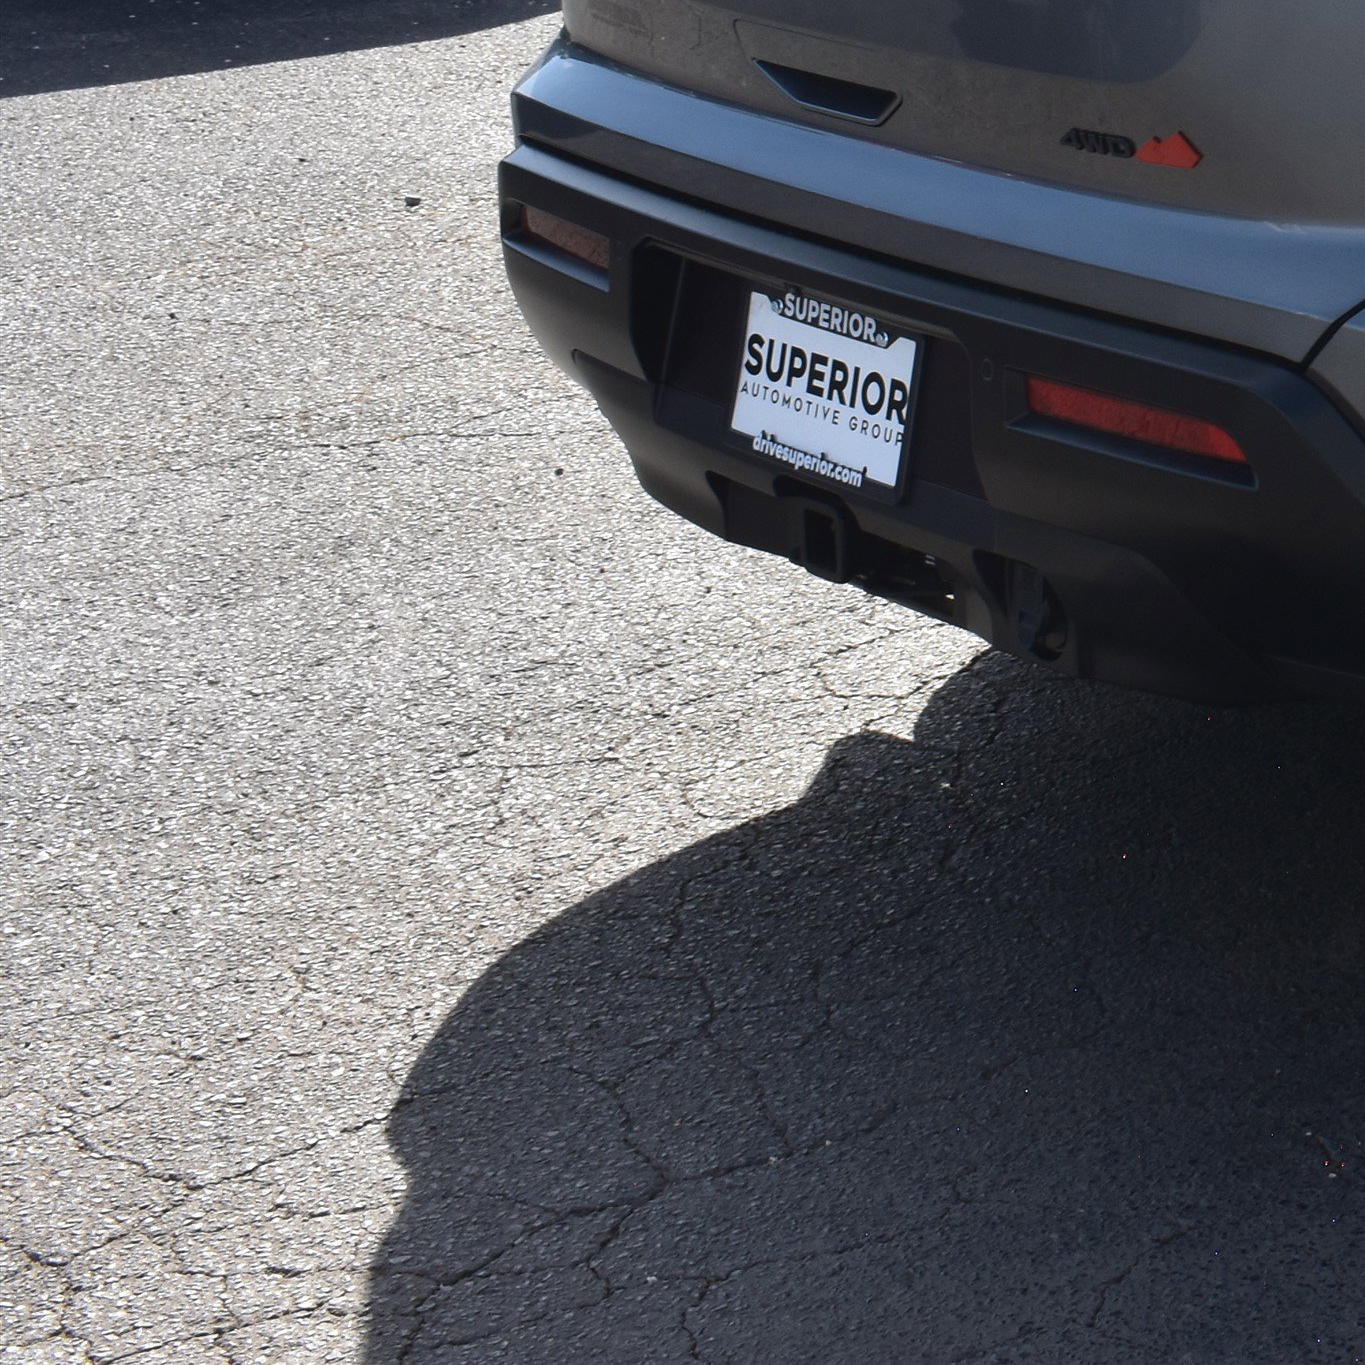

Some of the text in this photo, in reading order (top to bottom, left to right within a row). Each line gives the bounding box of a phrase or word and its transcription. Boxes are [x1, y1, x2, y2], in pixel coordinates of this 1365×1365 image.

[784, 291, 877, 343] SUPERIOR
[744, 333, 909, 426] SUPERIOR
[740, 380, 904, 447] AUTOMOTIVE GROUP
[752, 433, 864, 488] drivesuperior.com
